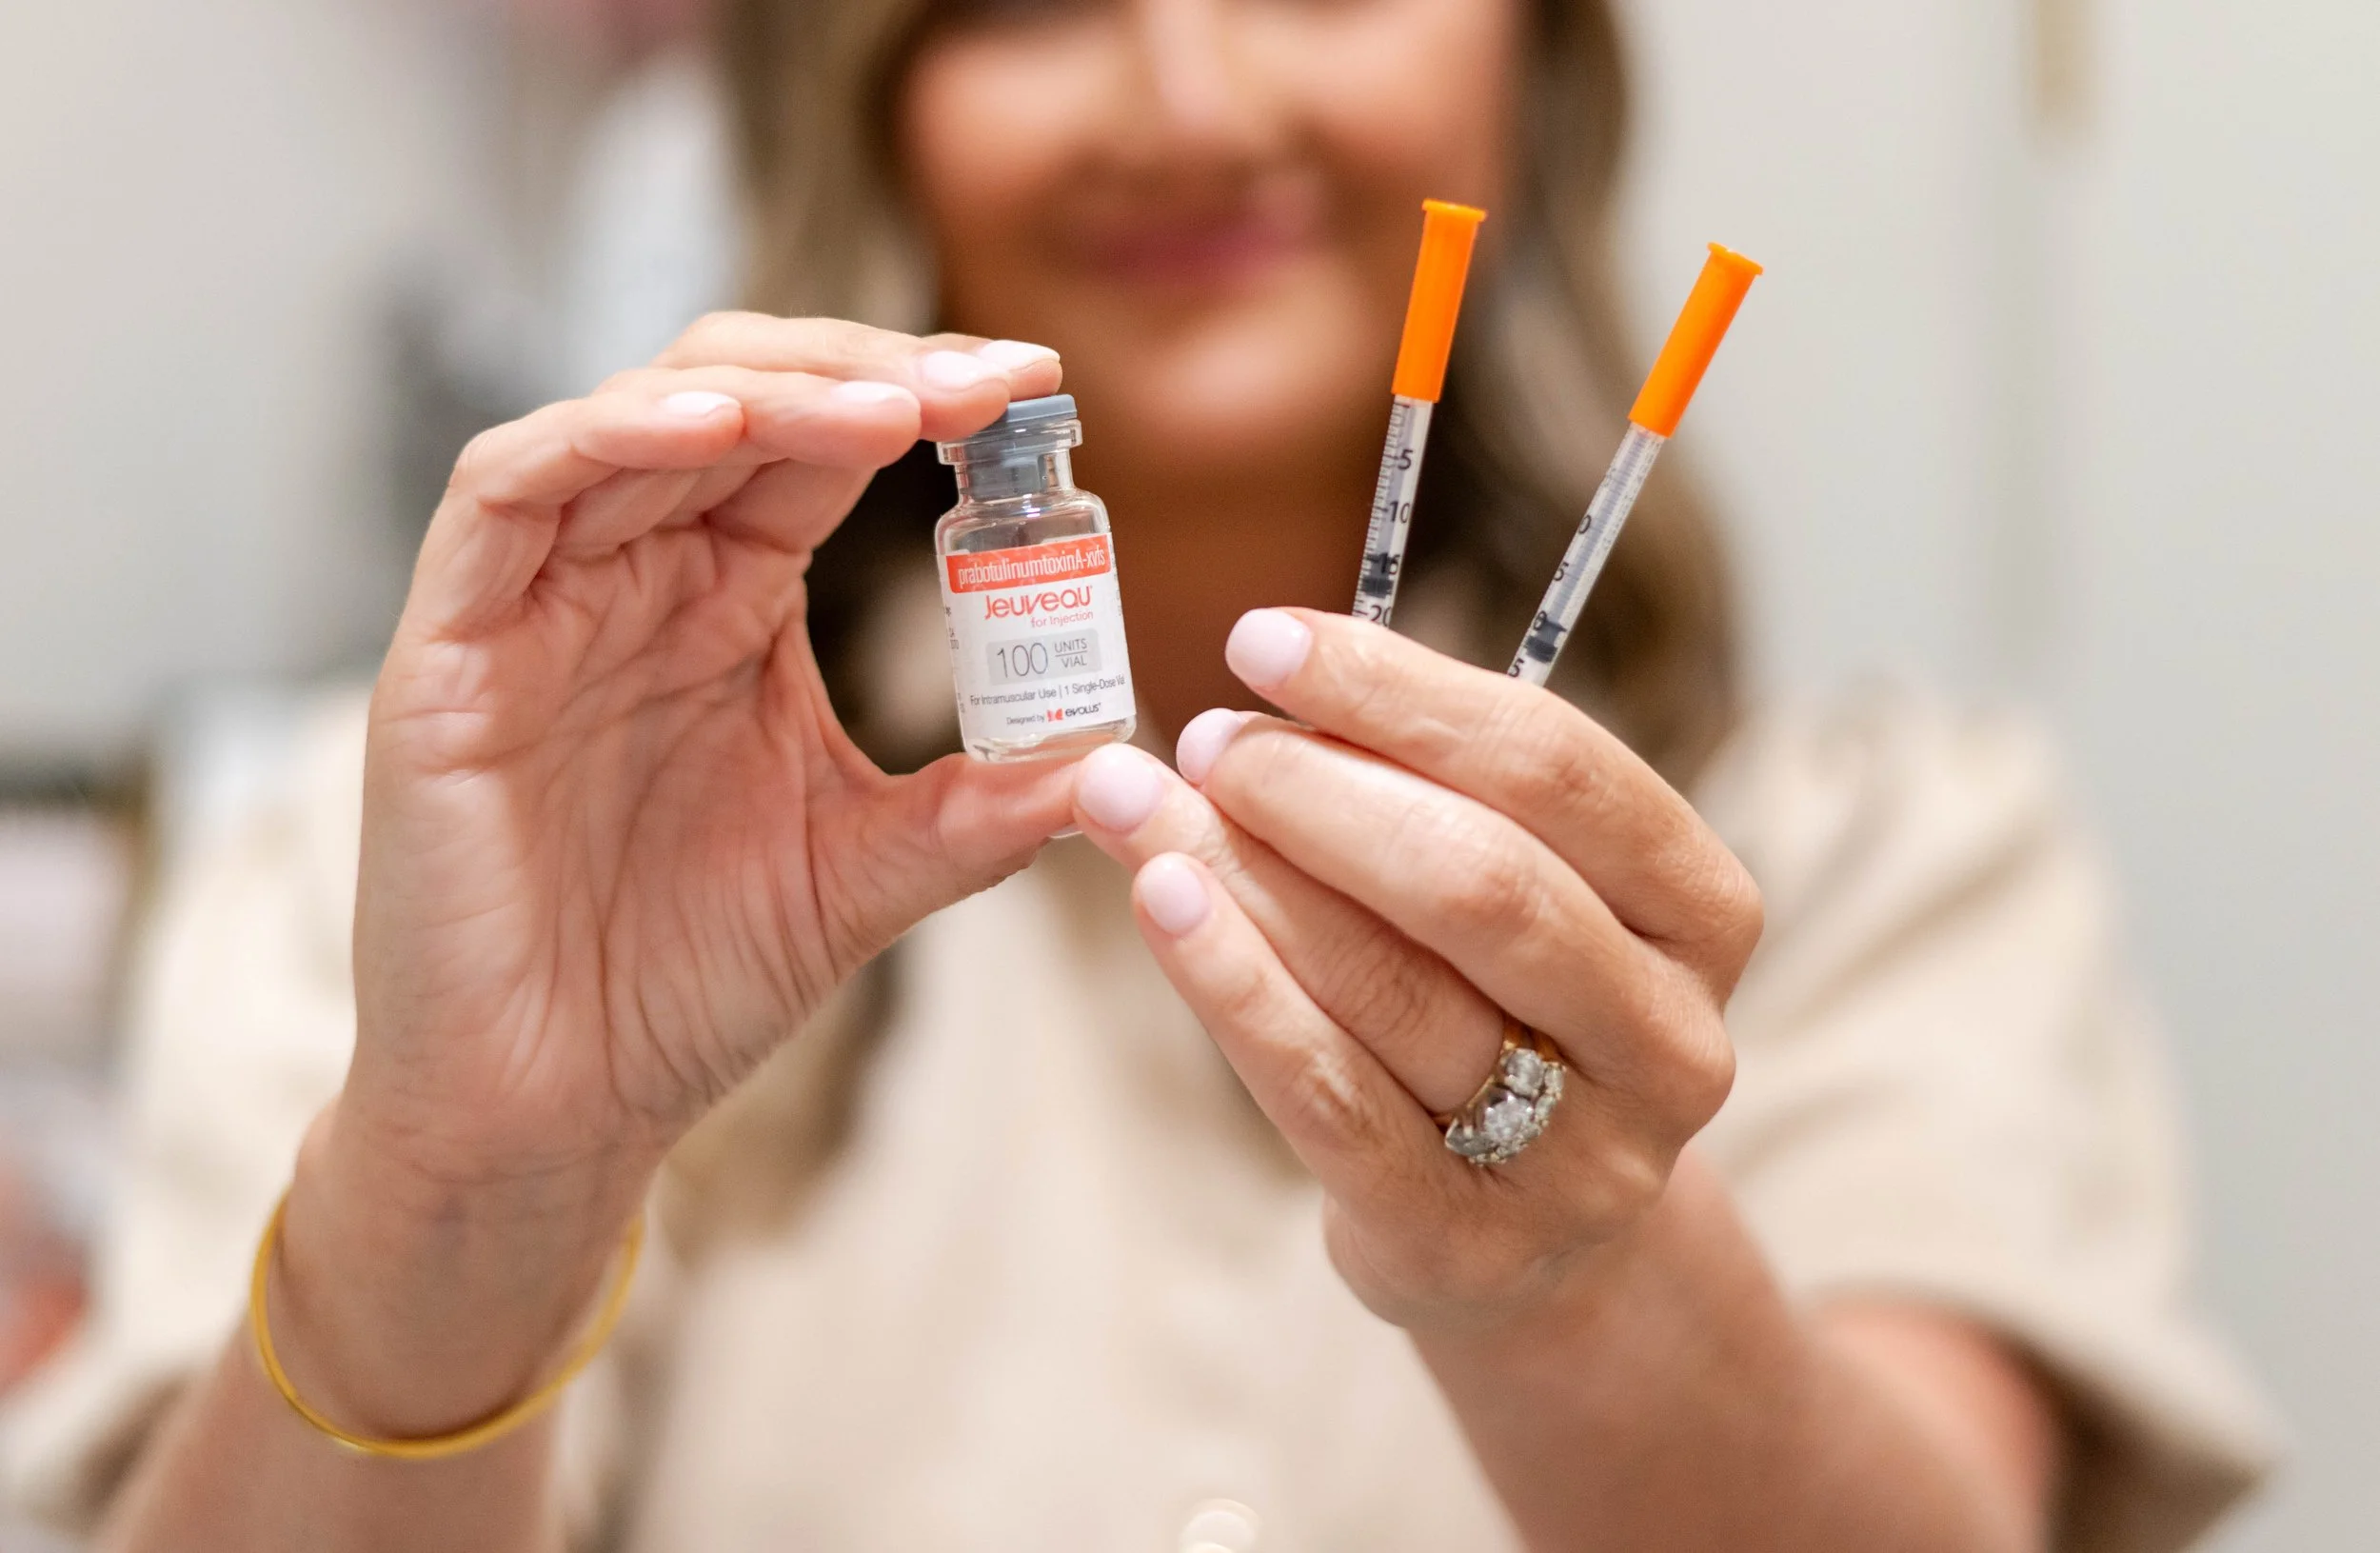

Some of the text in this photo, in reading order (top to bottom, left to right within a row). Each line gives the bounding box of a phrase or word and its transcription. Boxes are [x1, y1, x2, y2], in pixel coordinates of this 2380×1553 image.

[1398, 448, 1413, 470] 5
[1390, 501, 1410, 523] 10
[1031, 617, 1046, 628] for
[1054, 638, 1087, 653] UNITS
[997, 642, 1048, 678] 100
[1061, 655, 1087, 667] VIAL
[982, 690, 1036, 705] Intramuscular
[1039, 688, 1057, 699] Use
[1072, 678, 1116, 694] Single-Dose
[1006, 713, 1045, 726] Designed by
